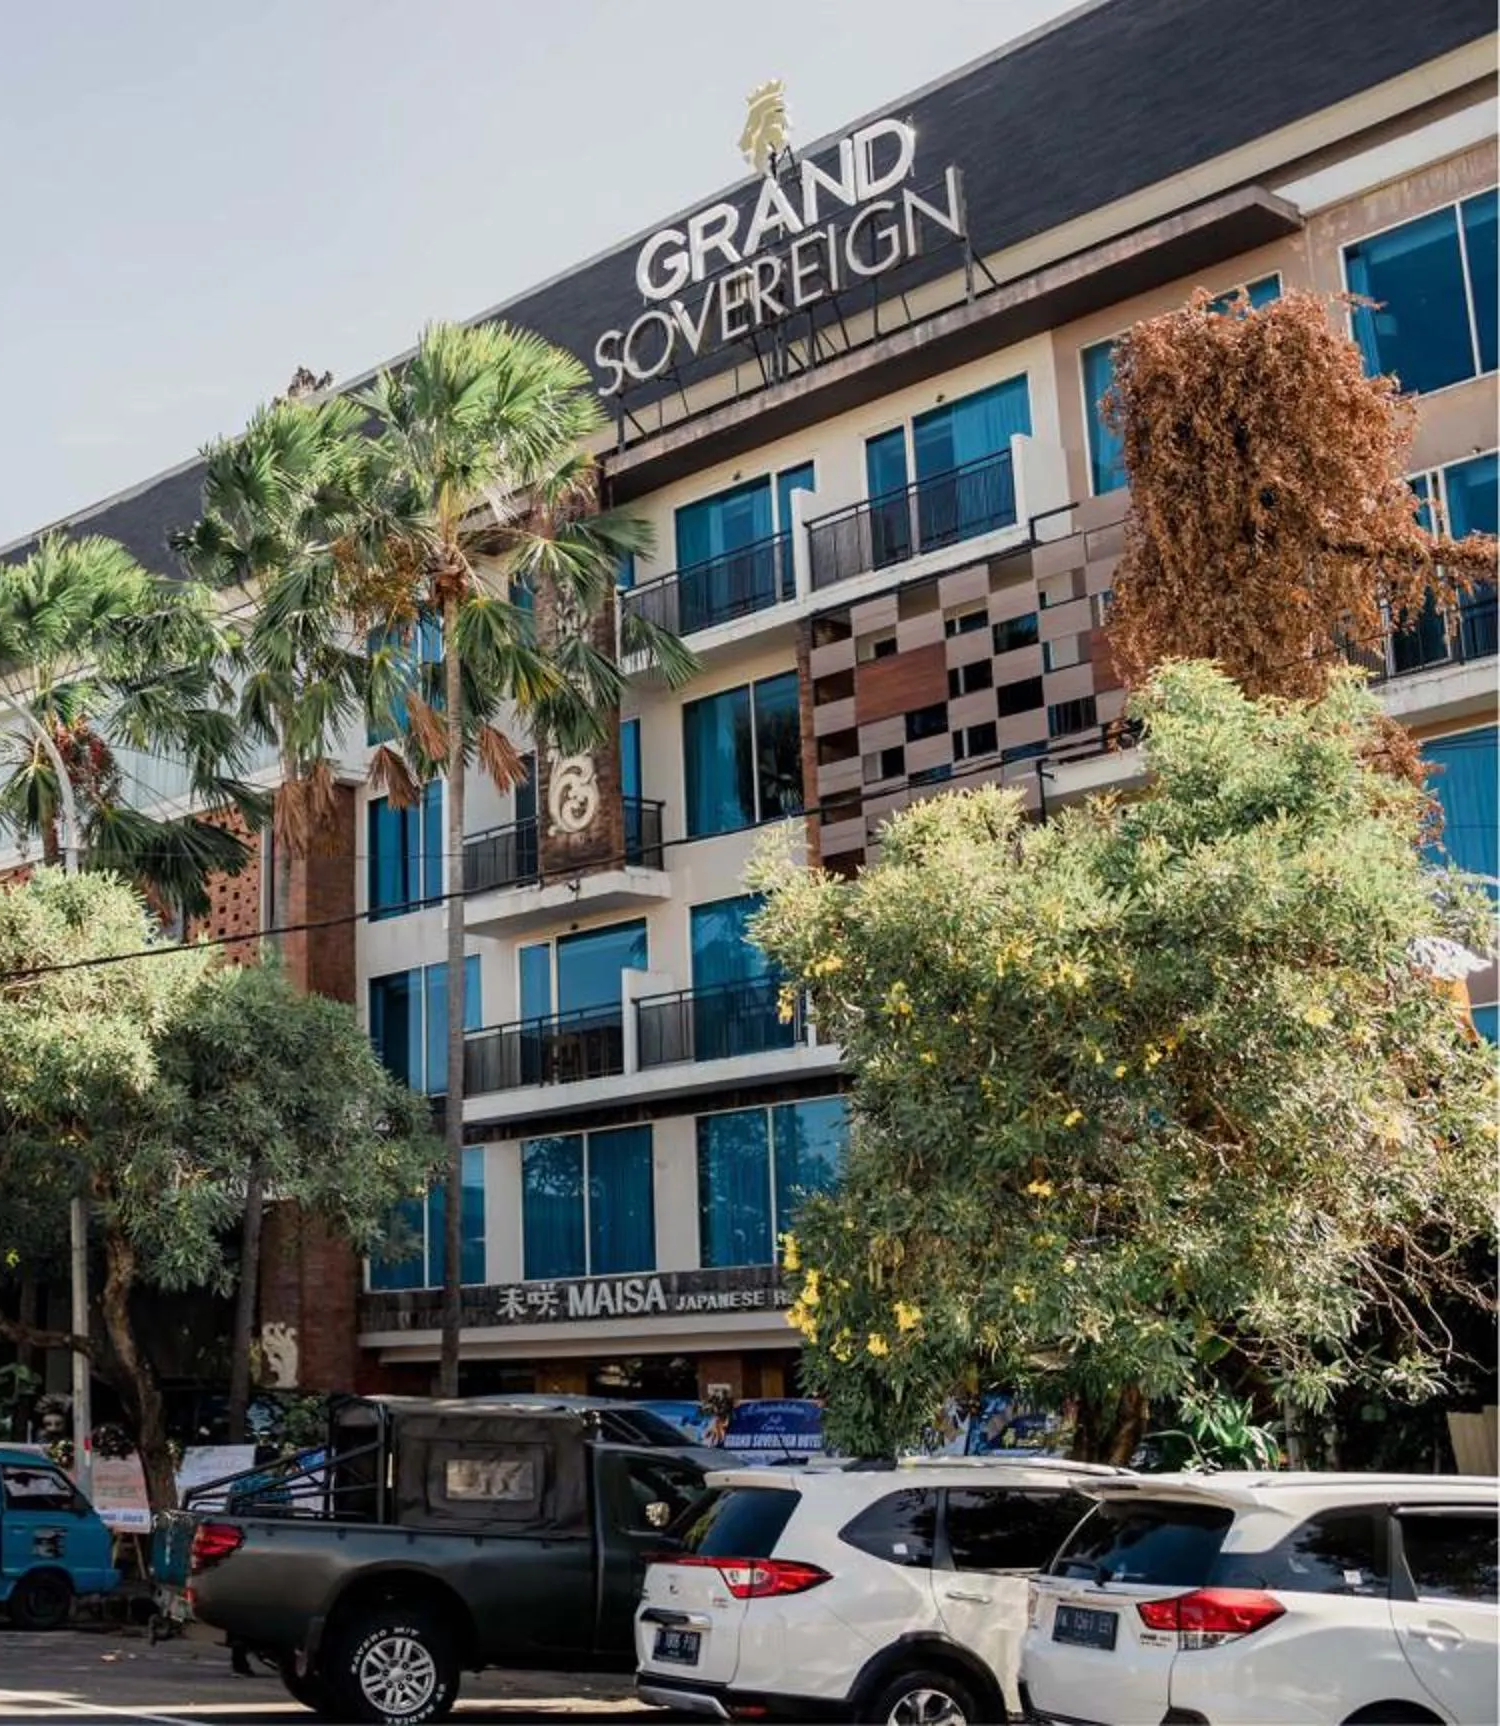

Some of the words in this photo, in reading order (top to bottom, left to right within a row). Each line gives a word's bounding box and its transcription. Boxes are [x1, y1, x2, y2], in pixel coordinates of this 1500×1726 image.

[594, 164, 964, 397] SOVEREIGN
[635, 119, 916, 300] GRAND
[568, 1278, 667, 1318] MAISA
[675, 1290, 765, 1312] JAPANESE
